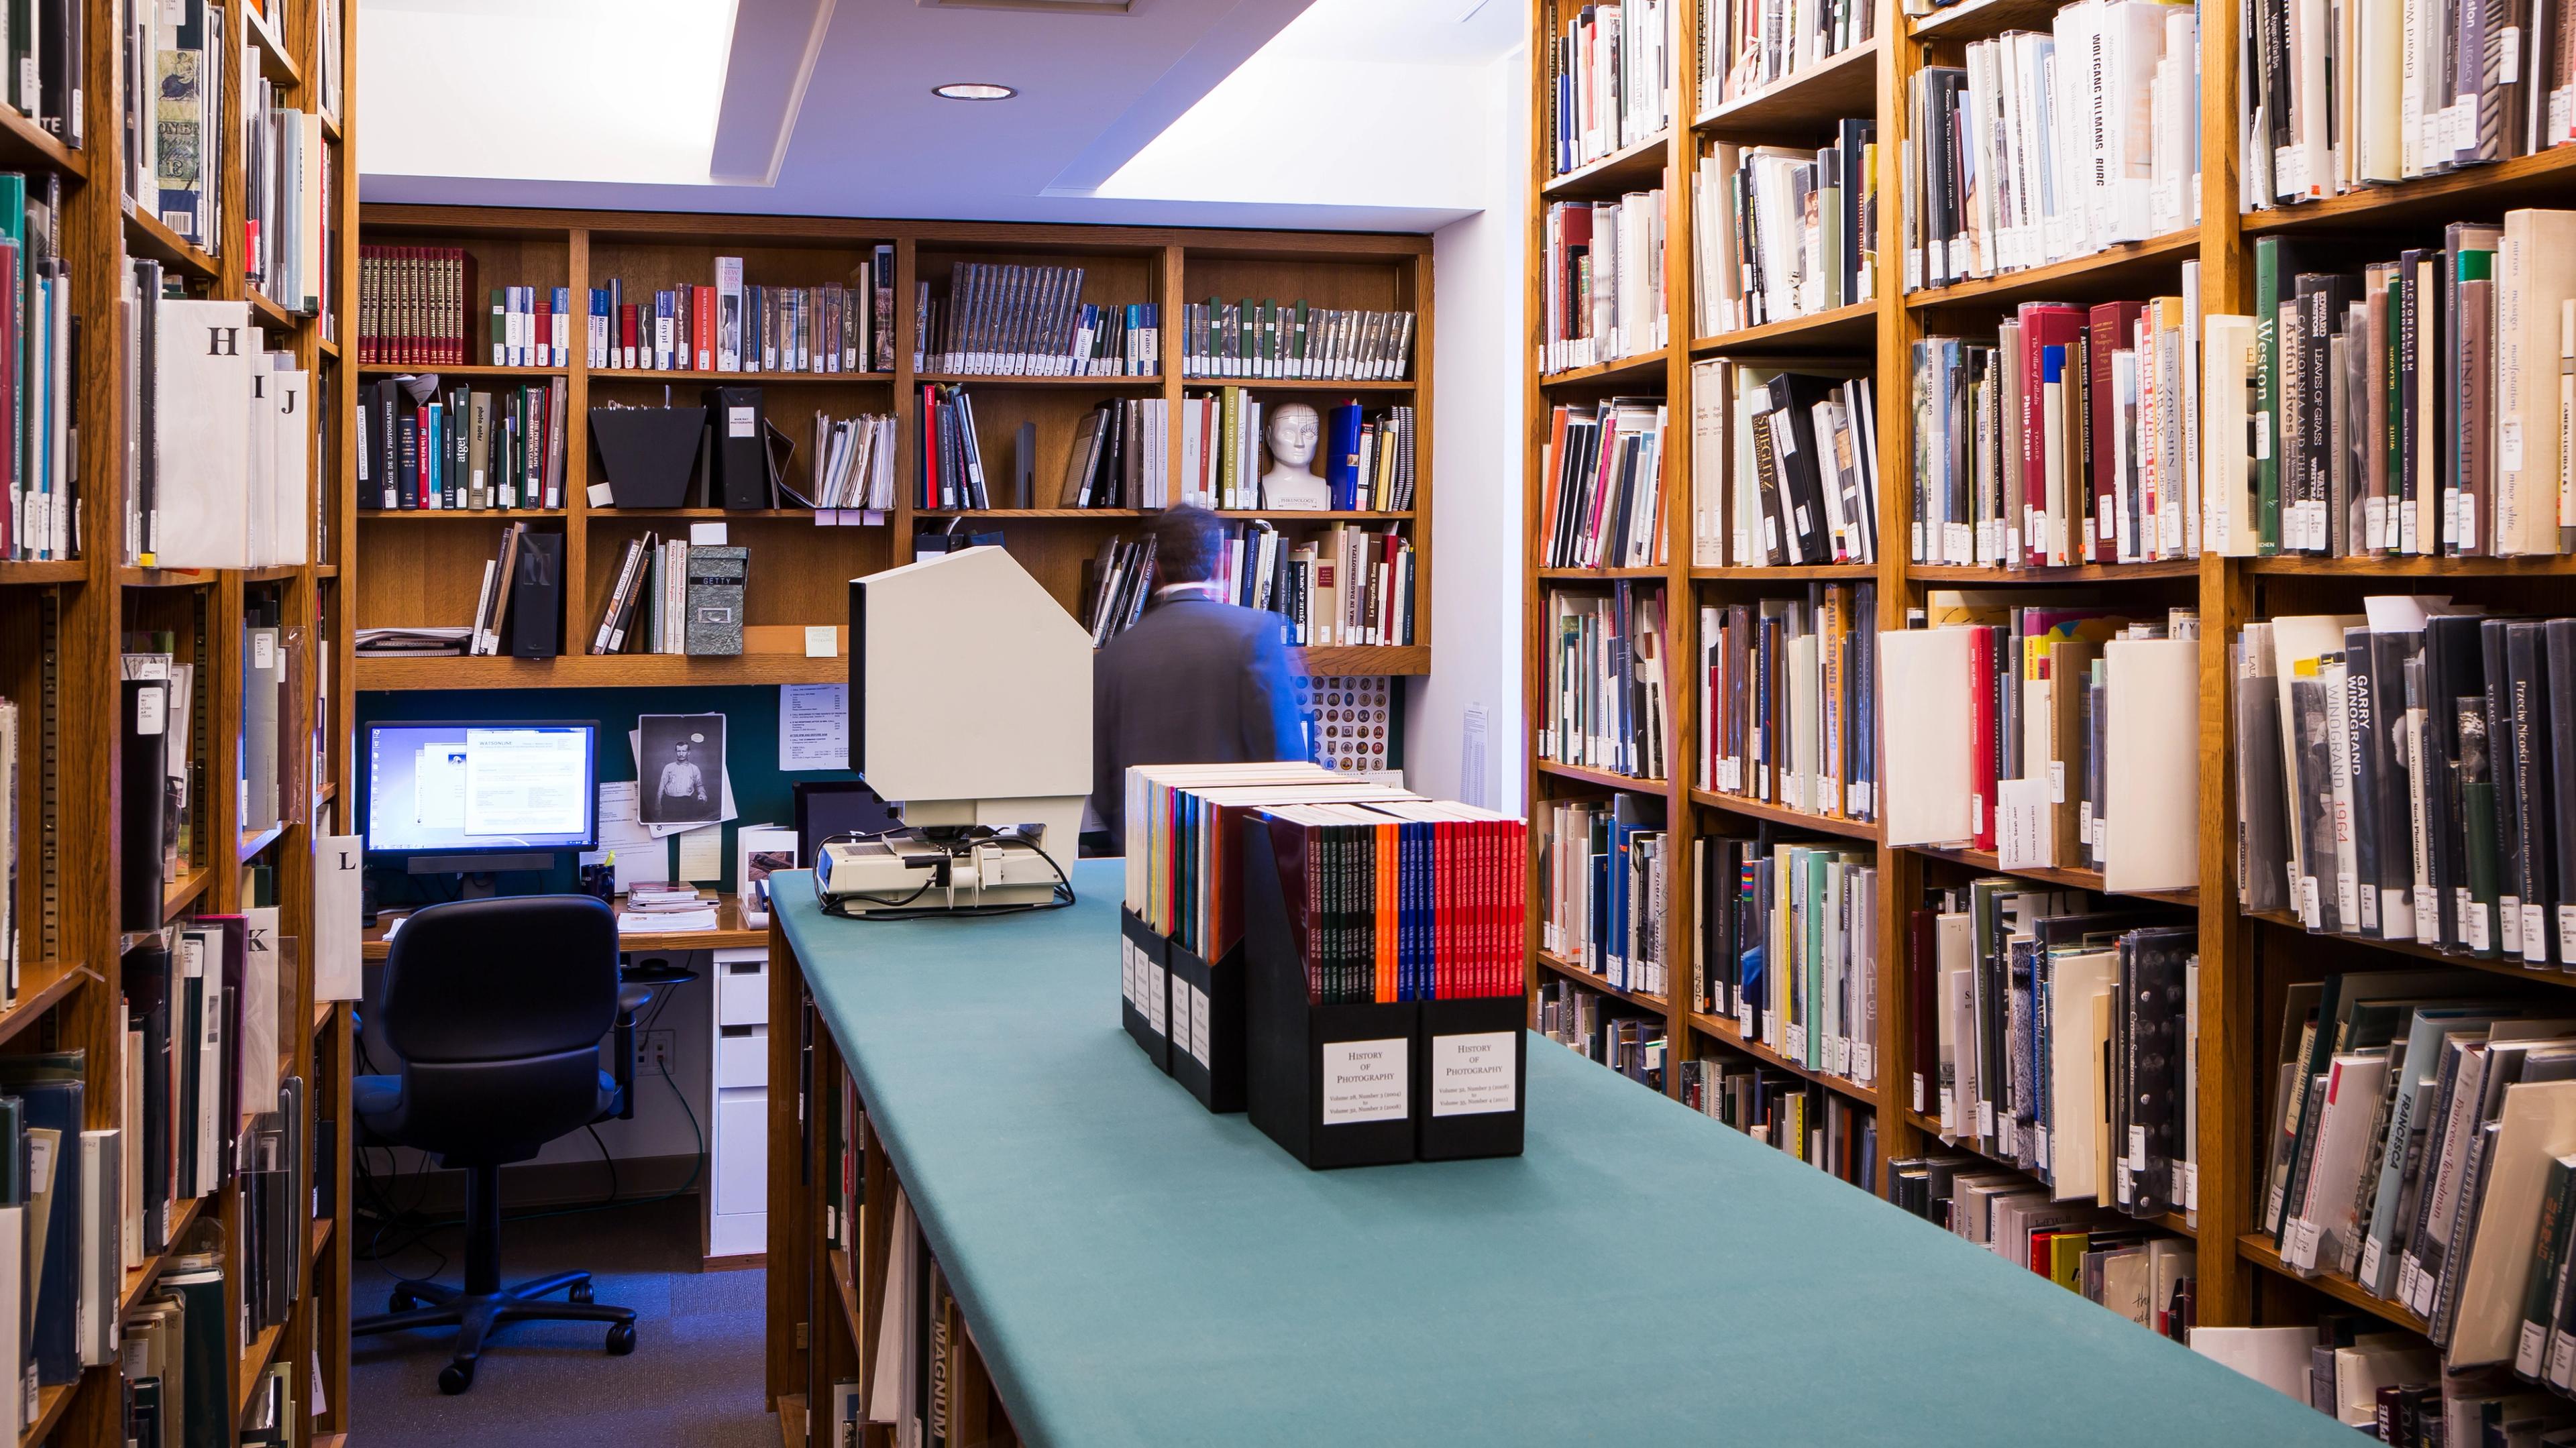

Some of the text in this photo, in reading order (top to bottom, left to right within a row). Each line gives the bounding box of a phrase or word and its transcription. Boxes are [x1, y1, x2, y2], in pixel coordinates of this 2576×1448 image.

[2406, 28, 2414, 79] Edward
[2092, 34, 2104, 186] WOLFGANG TILLMANS BURG
[2318, 290, 2327, 337] EDWARD
[206, 327, 240, 357] H
[2257, 318, 2273, 401] Weston
[254, 375, 265, 399] I
[2032, 371, 2039, 379] of
[2286, 322, 2296, 433] Artful Lives
[2314, 347, 2323, 446] LEAVES OF GRASS
[2510, 345, 2519, 411] manifestations
[280, 390, 298, 414] J
[2143, 335, 2155, 494] TSENG KWONG CHI
[2297, 315, 2306, 482] CALIFORNIA AND THE
[2461, 339, 2473, 491] MINOR WHITE
[456, 436, 469, 463] atget
[2023, 428, 2031, 461] Trager
[2166, 388, 2175, 467] ZOKUSHIN
[387, 460, 394, 469] DE
[1758, 414, 1774, 492] STIEGLITZ
[2508, 506, 2518, 531] white
[614, 545, 638, 599] STEPHEN SHORE
[1827, 598, 1838, 750] PAUL STRAND in MEXICO
[2356, 675, 2370, 730] GARRY
[2516, 681, 2526, 722] Przeciw
[2347, 675, 2361, 775] WINOGRAND
[2518, 724, 2528, 765] Nicości
[2327, 684, 2349, 843] WINOGRAND 1964
[338, 851, 357, 871] L
[248, 928, 270, 952] K
[2036, 950, 2045, 997] Vanished
[2037, 1001, 2046, 1039] World
[2129, 1011, 2137, 1040] Cross
[1348, 1052, 1383, 1061] HISTORY
[1458, 1044, 1492, 1054] HISTORY
[2305, 1034, 2314, 1062] LOOKING
[1337, 1073, 1395, 1084] PHOTOGRAPHY
[1446, 1065, 1503, 1076] PHOTOGRAPHY
[1358, 1092, 1379, 1100] Number
[2390, 1092, 2412, 1170] FRANCESCA
[2433, 1099, 2465, 1219] Francesca Woodman
[2035, 1215, 2072, 1228] Jeff Wall
[933, 1320, 947, 1439] MAGNUM
